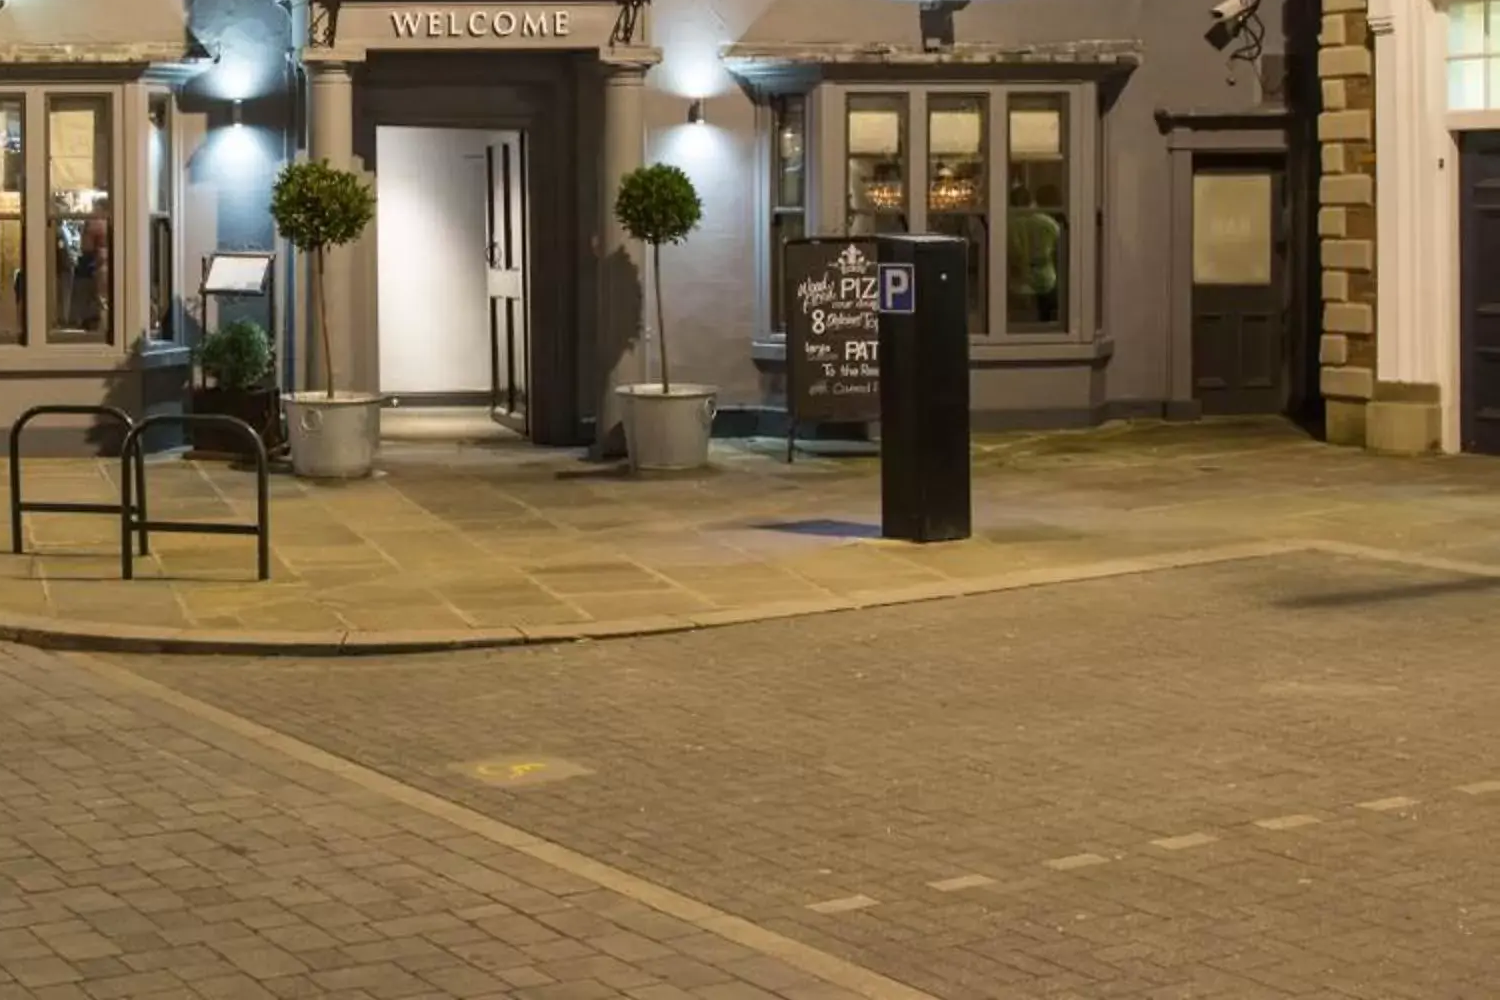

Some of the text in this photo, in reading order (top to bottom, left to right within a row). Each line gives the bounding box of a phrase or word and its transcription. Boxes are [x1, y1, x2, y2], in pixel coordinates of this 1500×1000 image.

[388, 10, 571, 38] WELCOME
[840, 277, 878, 299] PIZ
[884, 268, 910, 309] P
[812, 309, 826, 334] 8
